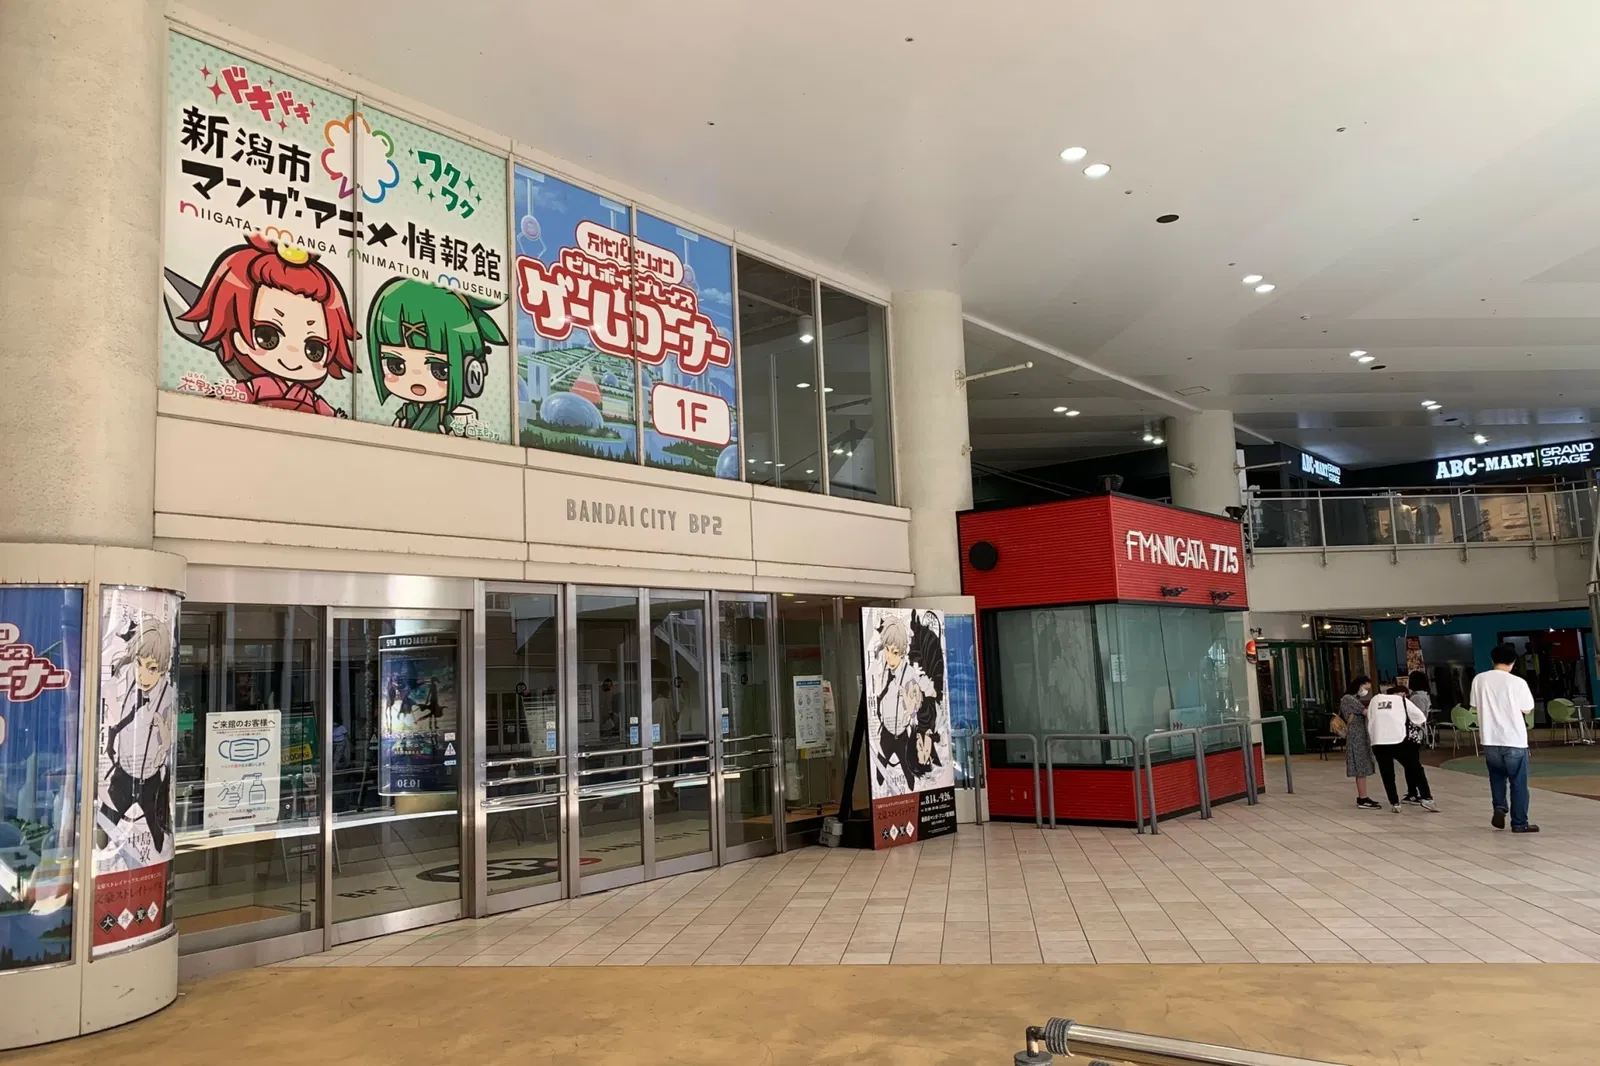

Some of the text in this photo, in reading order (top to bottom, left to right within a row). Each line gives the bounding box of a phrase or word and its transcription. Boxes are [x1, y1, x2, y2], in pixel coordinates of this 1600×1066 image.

[221, 66, 311, 125] ドキドキ
[181, 105, 311, 183] 新潟市
[520, 263, 729, 367] ゲームコーナー
[676, 398, 708, 432] 1F
[1436, 442, 1594, 479] ABC-MART GRAND
[1542, 453, 1591, 467] STAGE
[689, 513, 723, 536] BP2
[212, 718, 276, 730] ご来館のお客様へ
